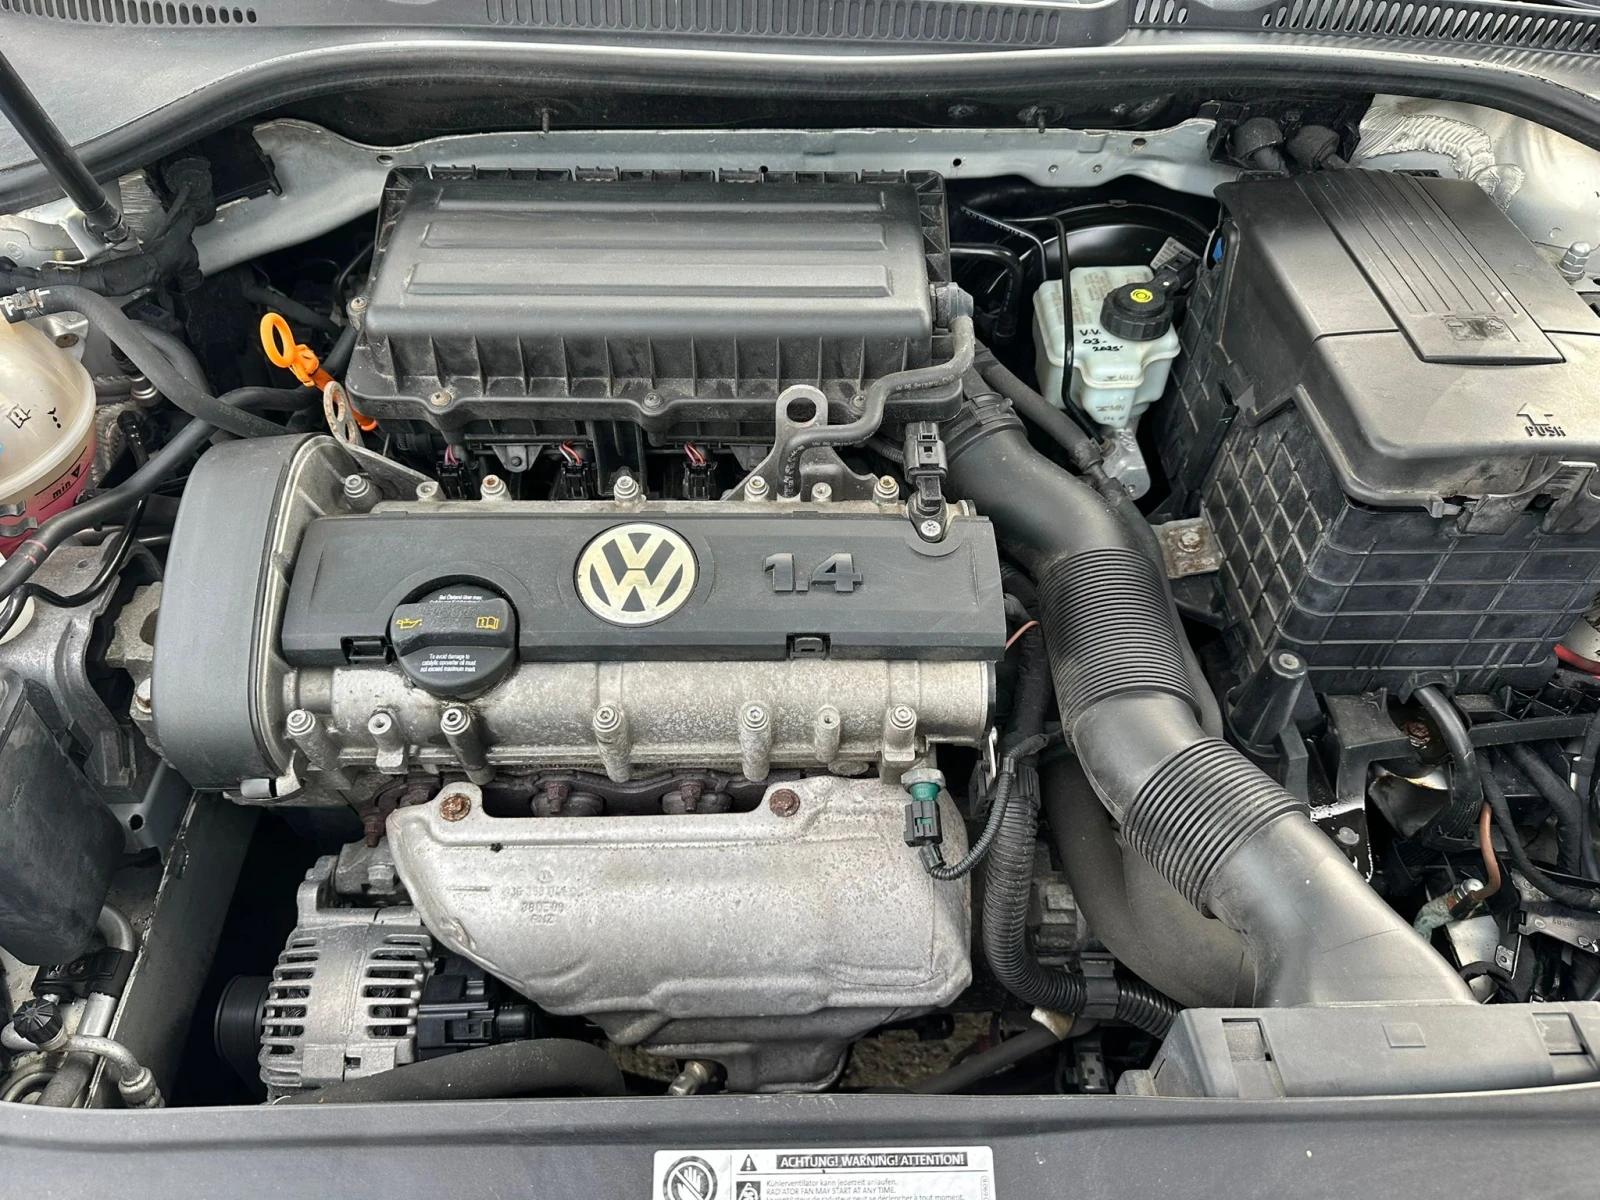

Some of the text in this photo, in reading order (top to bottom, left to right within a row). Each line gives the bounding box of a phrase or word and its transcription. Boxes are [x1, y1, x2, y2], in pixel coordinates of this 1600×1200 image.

[1524, 425, 1566, 437] PUSH
[52, 479, 72, 499] min
[577, 522, 697, 625] VW
[763, 552, 863, 593] 1.4
[780, 1154, 964, 1167] ACHTUNG! WARNING! ATTENTION!
[820, 1178, 836, 1186] kann
[800, 1187, 814, 1195] FAN
[862, 1186, 876, 1194] ANY
